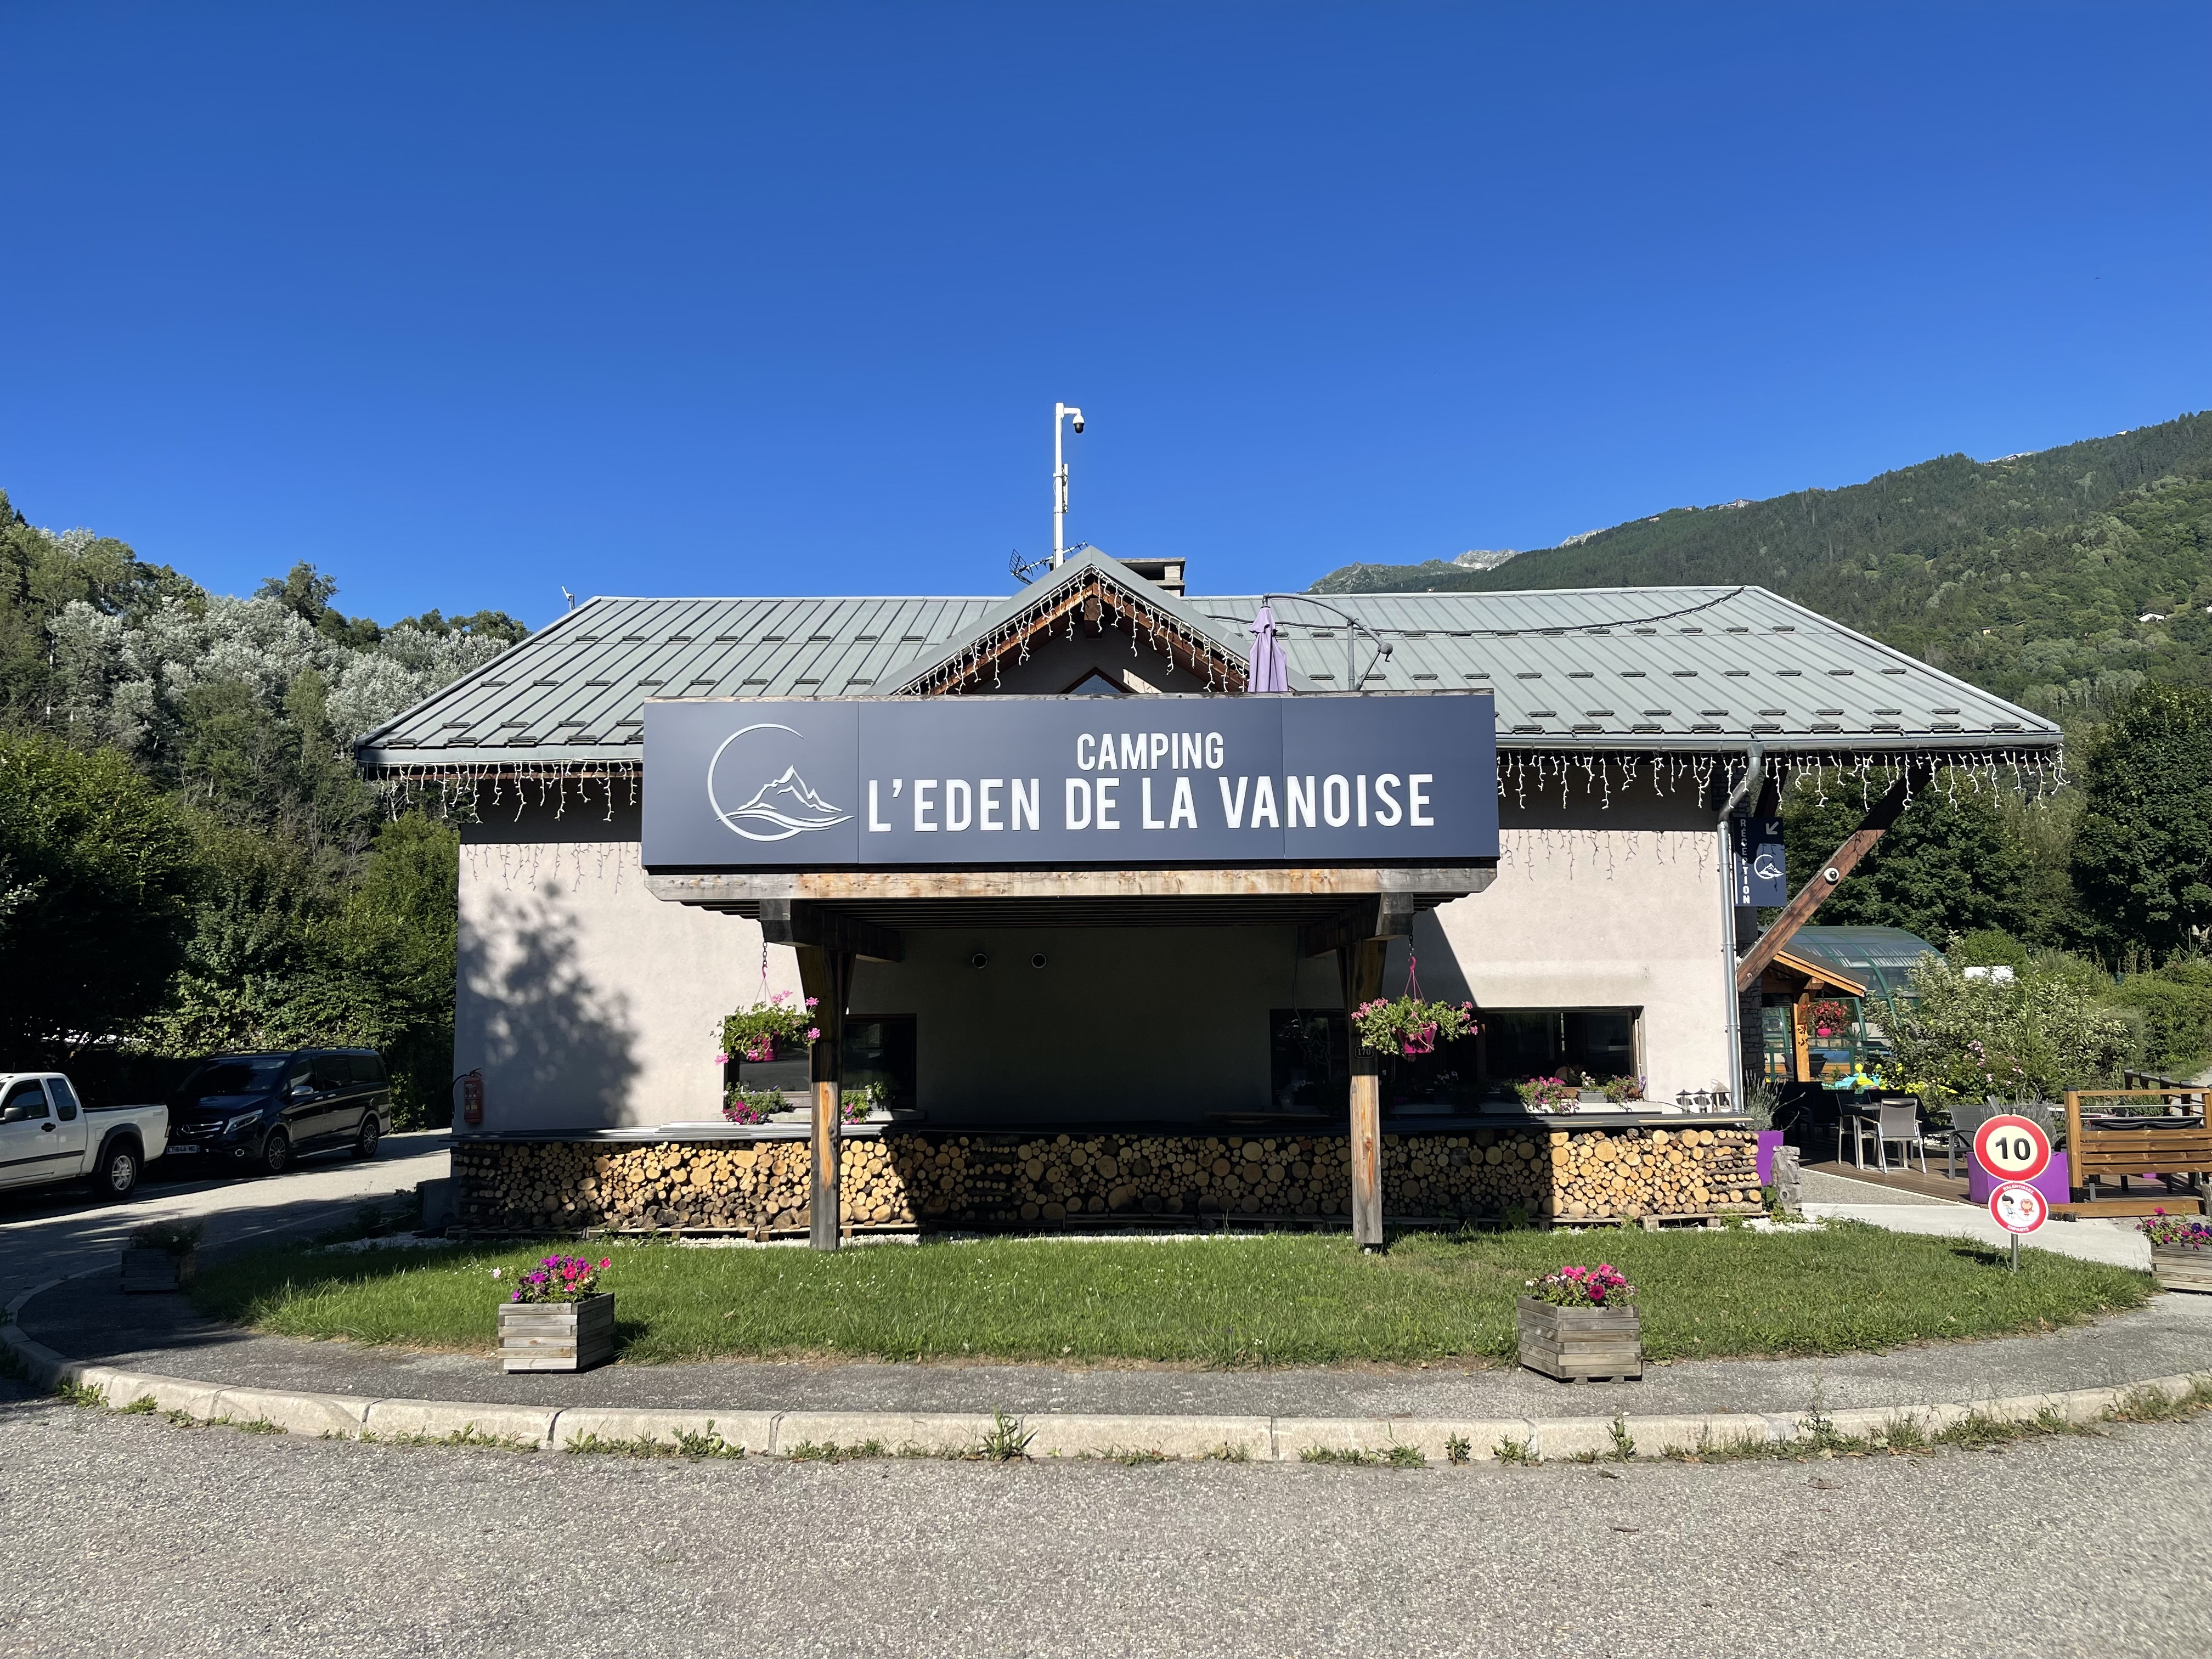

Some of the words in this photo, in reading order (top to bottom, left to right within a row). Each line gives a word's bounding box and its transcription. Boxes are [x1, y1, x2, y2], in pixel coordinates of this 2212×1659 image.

[1077, 732, 1224, 770] CAMPING
[868, 778, 1040, 832] L'EDEN
[1065, 777, 1120, 830] DE
[1142, 777, 1198, 830] LA
[1218, 772, 1434, 829] VANOISE
[1740, 819, 1750, 904] RÉCEPTION
[1995, 1137, 2031, 1160] 10
[2002, 1184, 2034, 1194] RALENTISSEZ
